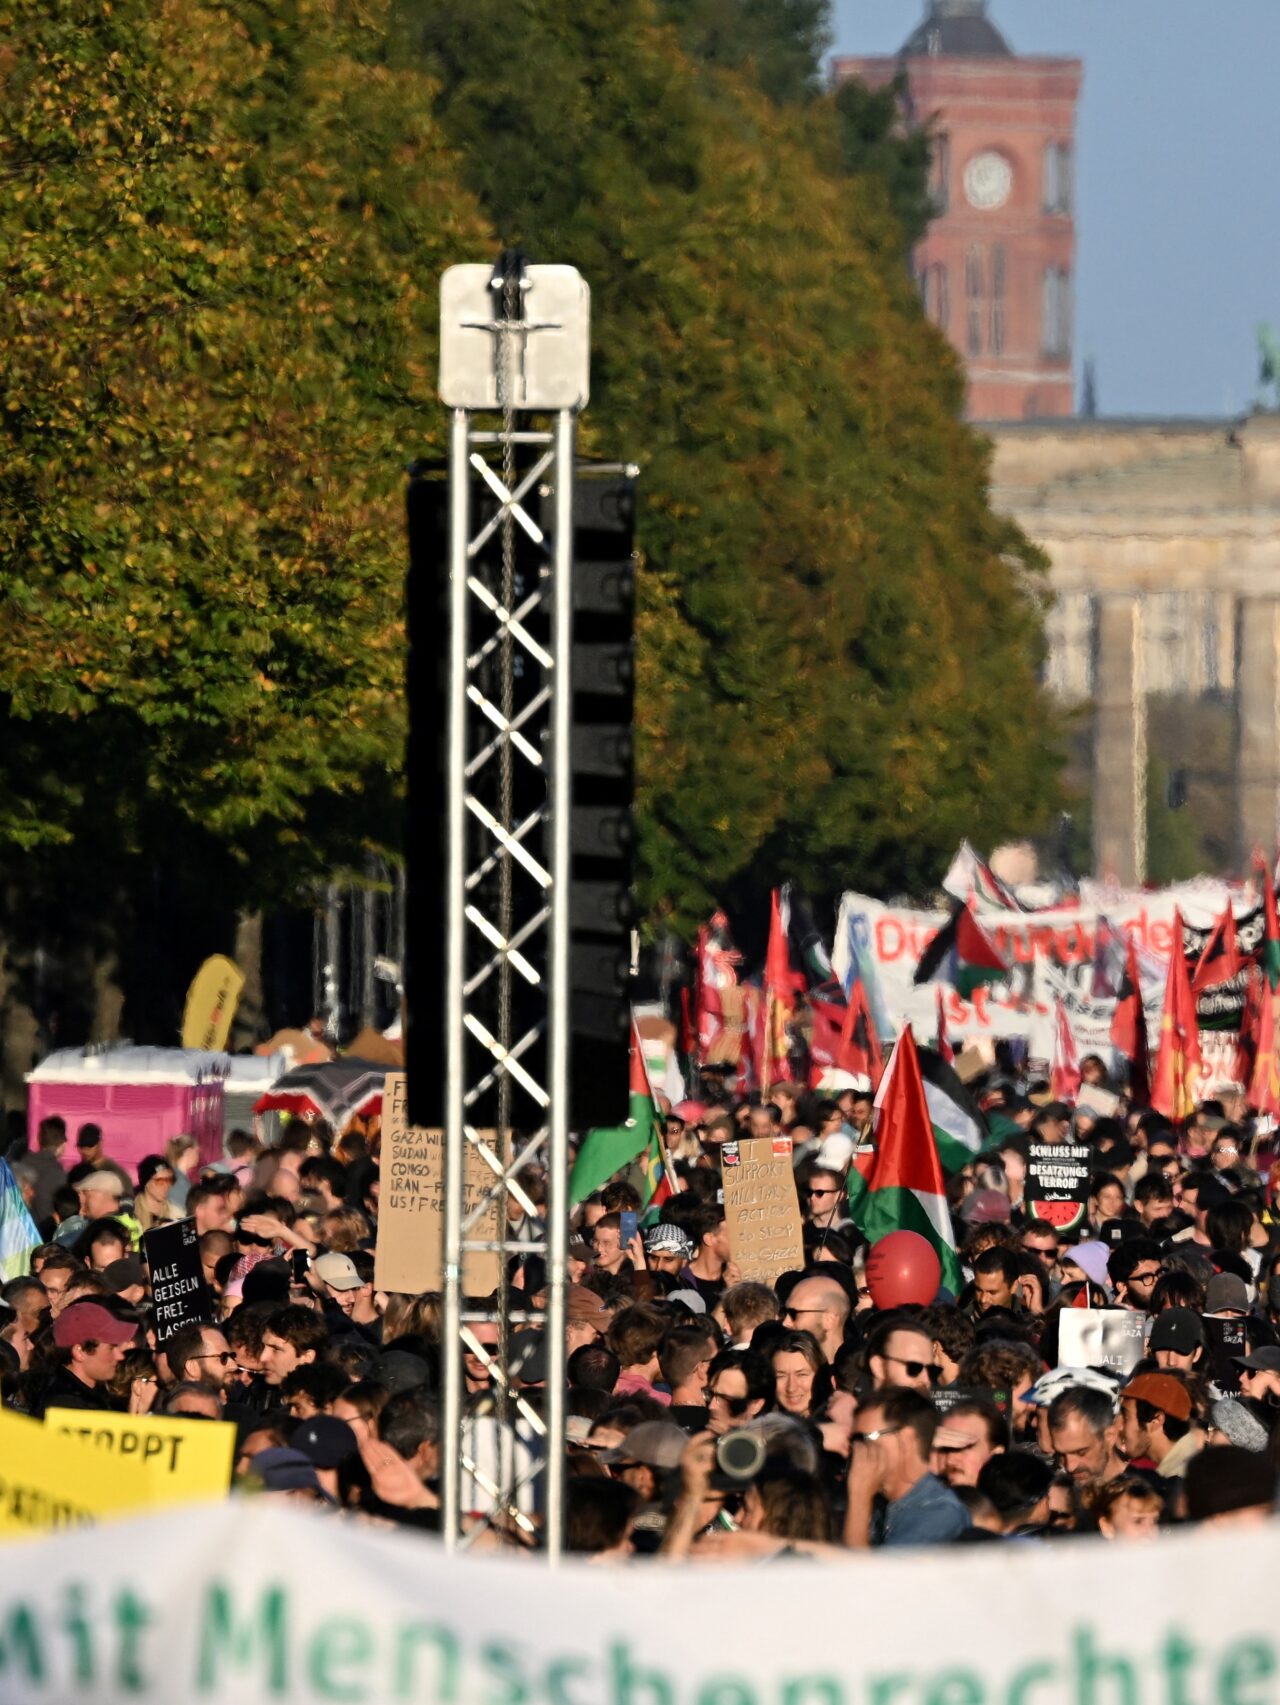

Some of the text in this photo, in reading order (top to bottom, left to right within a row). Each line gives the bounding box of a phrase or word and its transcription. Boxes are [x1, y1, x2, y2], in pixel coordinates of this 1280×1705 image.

[391, 1131, 424, 1144] GAZA
[392, 1146, 428, 1160] SUDAN
[743, 1140, 759, 1162] I
[1029, 1145, 1090, 1158] SCHLUSS MIT
[391, 1162, 430, 1177] CONGO
[725, 1161, 786, 1188] SUPPORT
[1029, 1164, 1088, 1178] BESATZUNGS
[390, 1178, 420, 1194] IRAN
[1038, 1176, 1079, 1189] TERROR!
[728, 1184, 792, 1206] MILITARY
[390, 1196, 416, 1212] US!
[759, 1223, 794, 1240] STOP
[153, 1263, 179, 1283] ALLE
[154, 1276, 199, 1302] GEISELN
[156, 1301, 188, 1322] FREI-
[59, 1424, 184, 1474] OPPT
